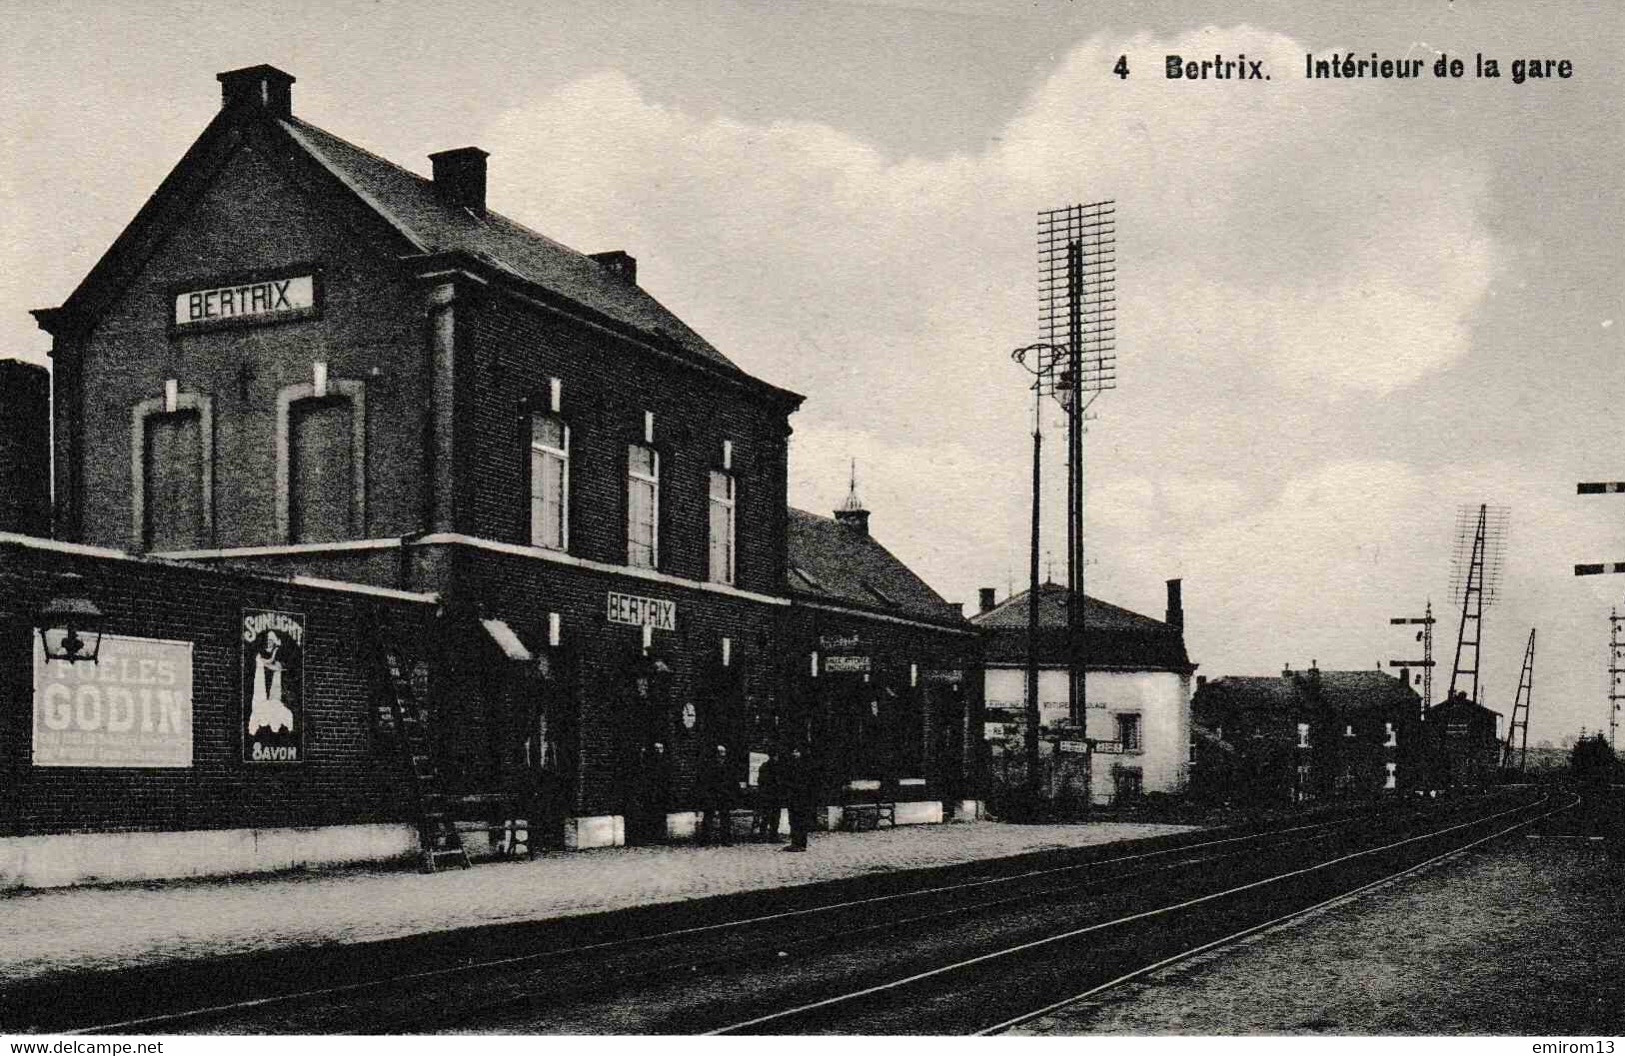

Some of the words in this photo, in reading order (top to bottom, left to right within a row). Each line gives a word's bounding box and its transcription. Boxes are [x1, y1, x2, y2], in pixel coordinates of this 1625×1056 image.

[189, 280, 291, 320] BERTRIX
[244, 613, 303, 646] SUNLIGHT
[610, 594, 672, 628] BERTRIX
[44, 683, 183, 733] GODIN
